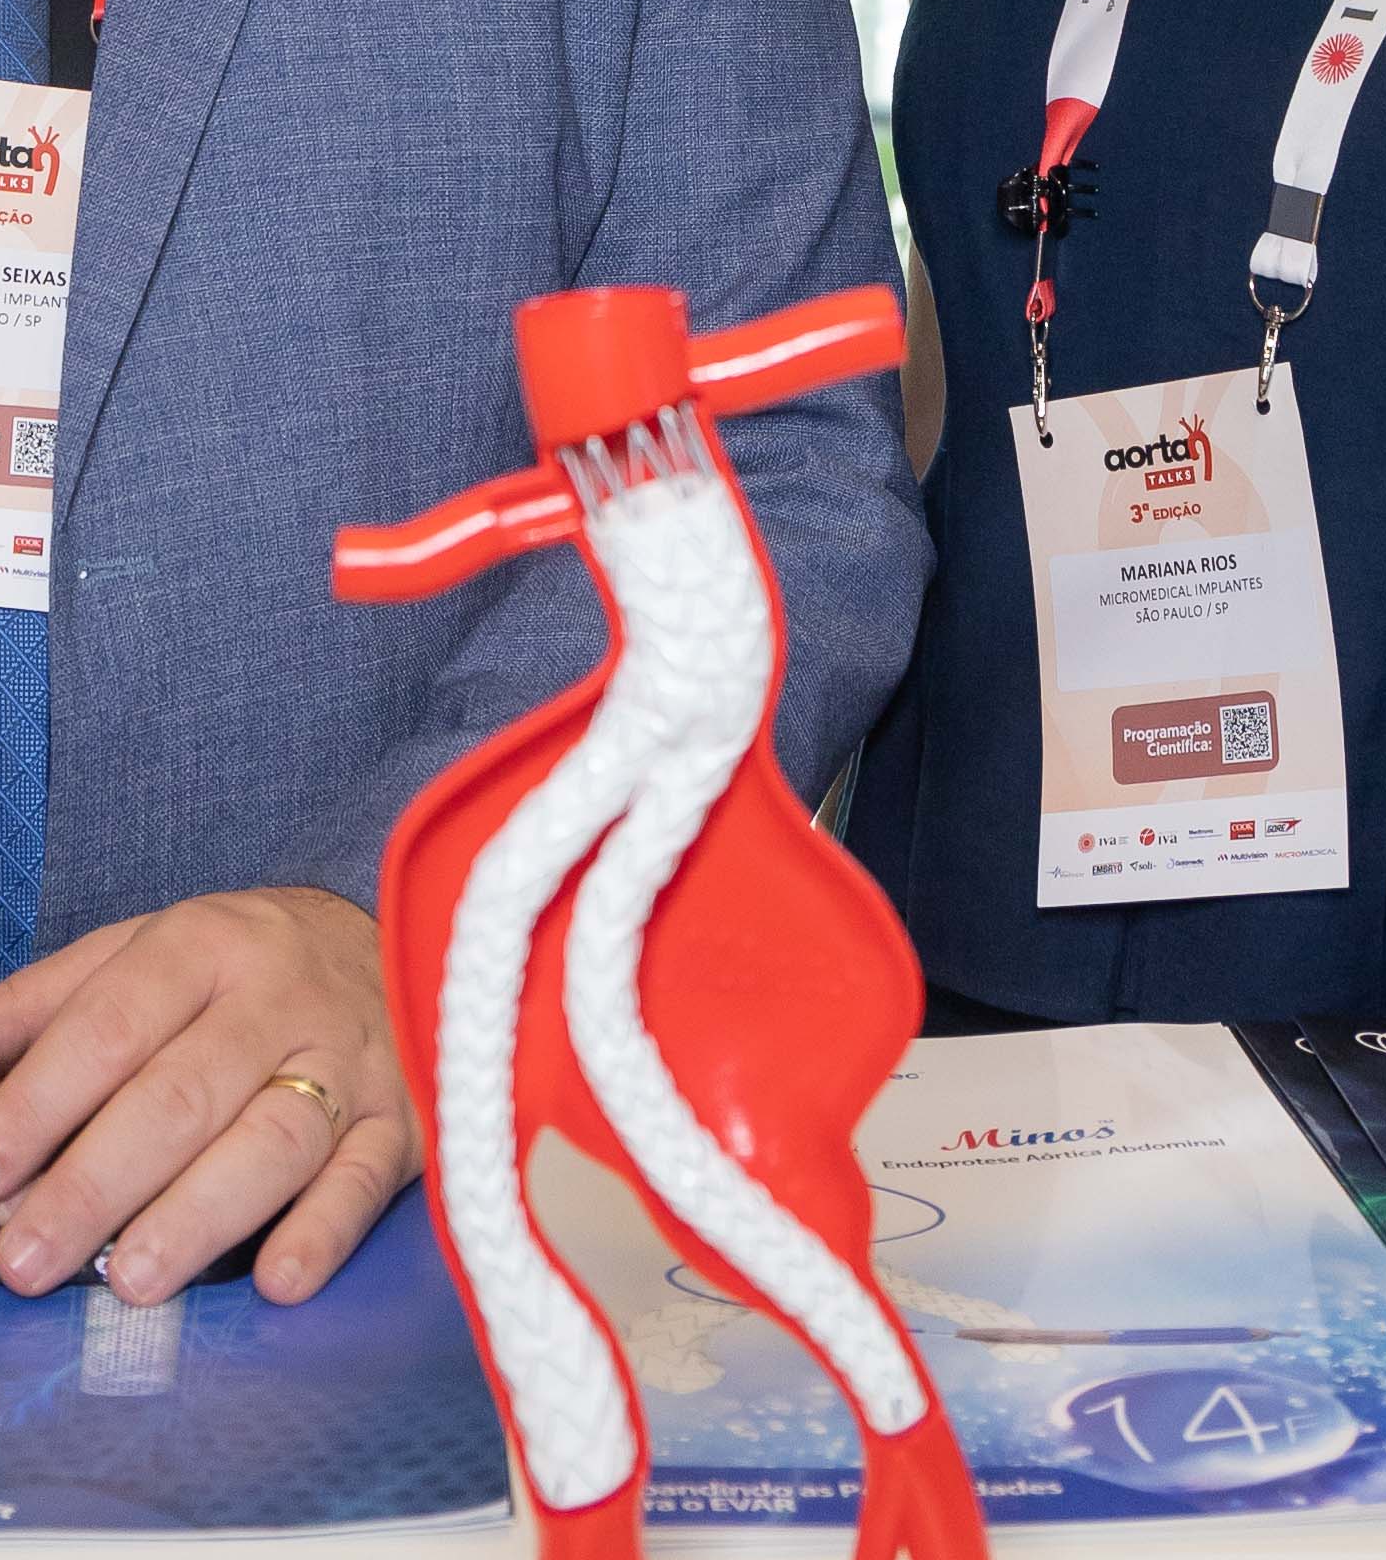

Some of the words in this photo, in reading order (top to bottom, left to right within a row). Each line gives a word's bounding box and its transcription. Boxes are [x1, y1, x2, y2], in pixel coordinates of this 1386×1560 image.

[2, 267, 67, 286] SEIXAS
[4, 293, 69, 309] IMPLANT
[13, 313, 20, 327] /
[25, 314, 42, 327] SP
[1104, 434, 1191, 472] aorta
[1148, 469, 1192, 486] TALKS
[1152, 502, 1202, 521] EDIÇÃO
[1121, 560, 1197, 582] MARIANA
[1201, 554, 1237, 573] RIOS
[1099, 585, 1192, 606] MICROMEDICAL
[1195, 577, 1263, 596] IMPLANTES
[1135, 607, 1160, 624] SÃO
[1164, 604, 1202, 620] PAULO
[1207, 602, 1212, 618] /
[1215, 601, 1229, 615] SP
[1123, 721, 1211, 743] Programação
[1147, 737, 1212, 757] Científica:
[1230, 852, 1269, 861] Multivision
[1275, 848, 1337, 859] MICROMEDICAL
[882, 1154, 1021, 1170] Endoprotese
[1025, 1146, 1103, 1164] Aórtica
[1108, 1137, 1227, 1156] Abdominal
[799, 1484, 835, 1498] as
[681, 1499, 701, 1513] o
[708, 1498, 797, 1513] EVAR
